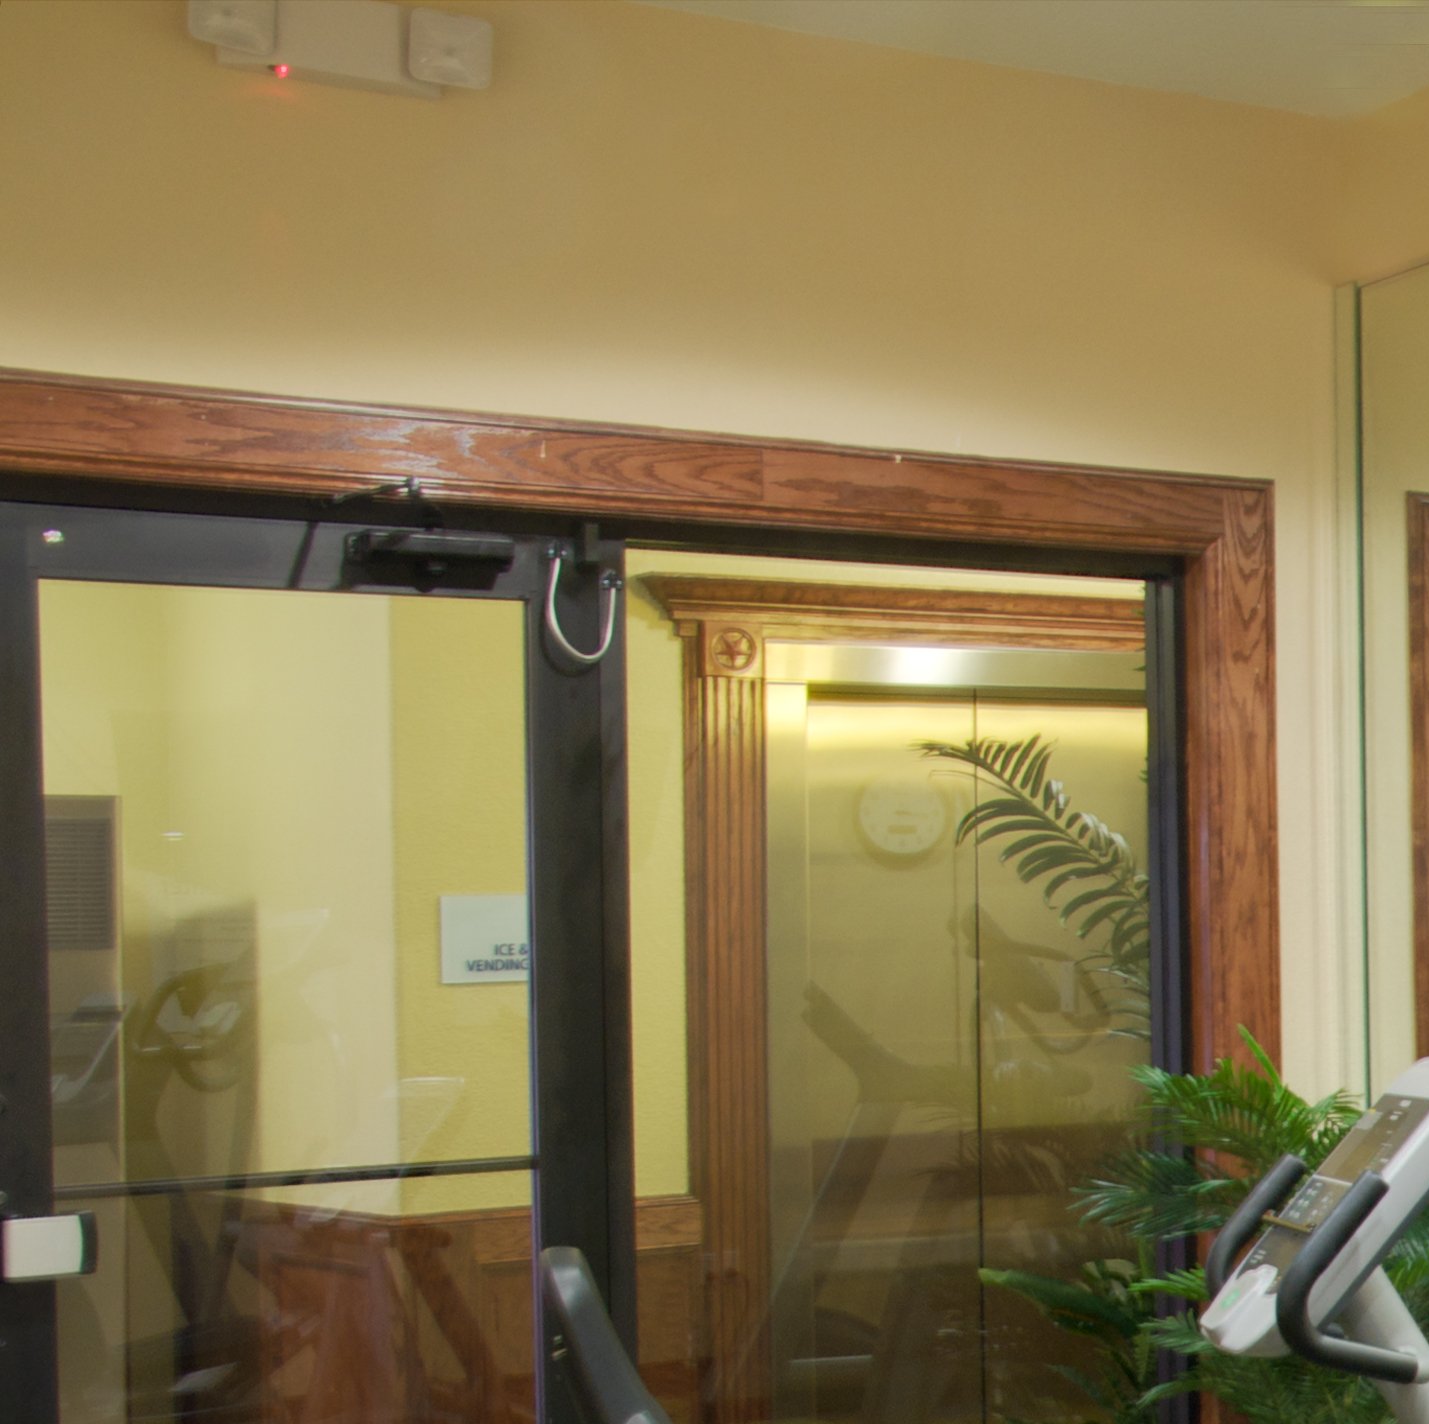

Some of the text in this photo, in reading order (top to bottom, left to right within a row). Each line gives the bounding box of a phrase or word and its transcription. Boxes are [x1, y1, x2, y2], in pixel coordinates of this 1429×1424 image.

[494, 943, 529, 956] ICE &
[465, 959, 530, 972] VENDING
